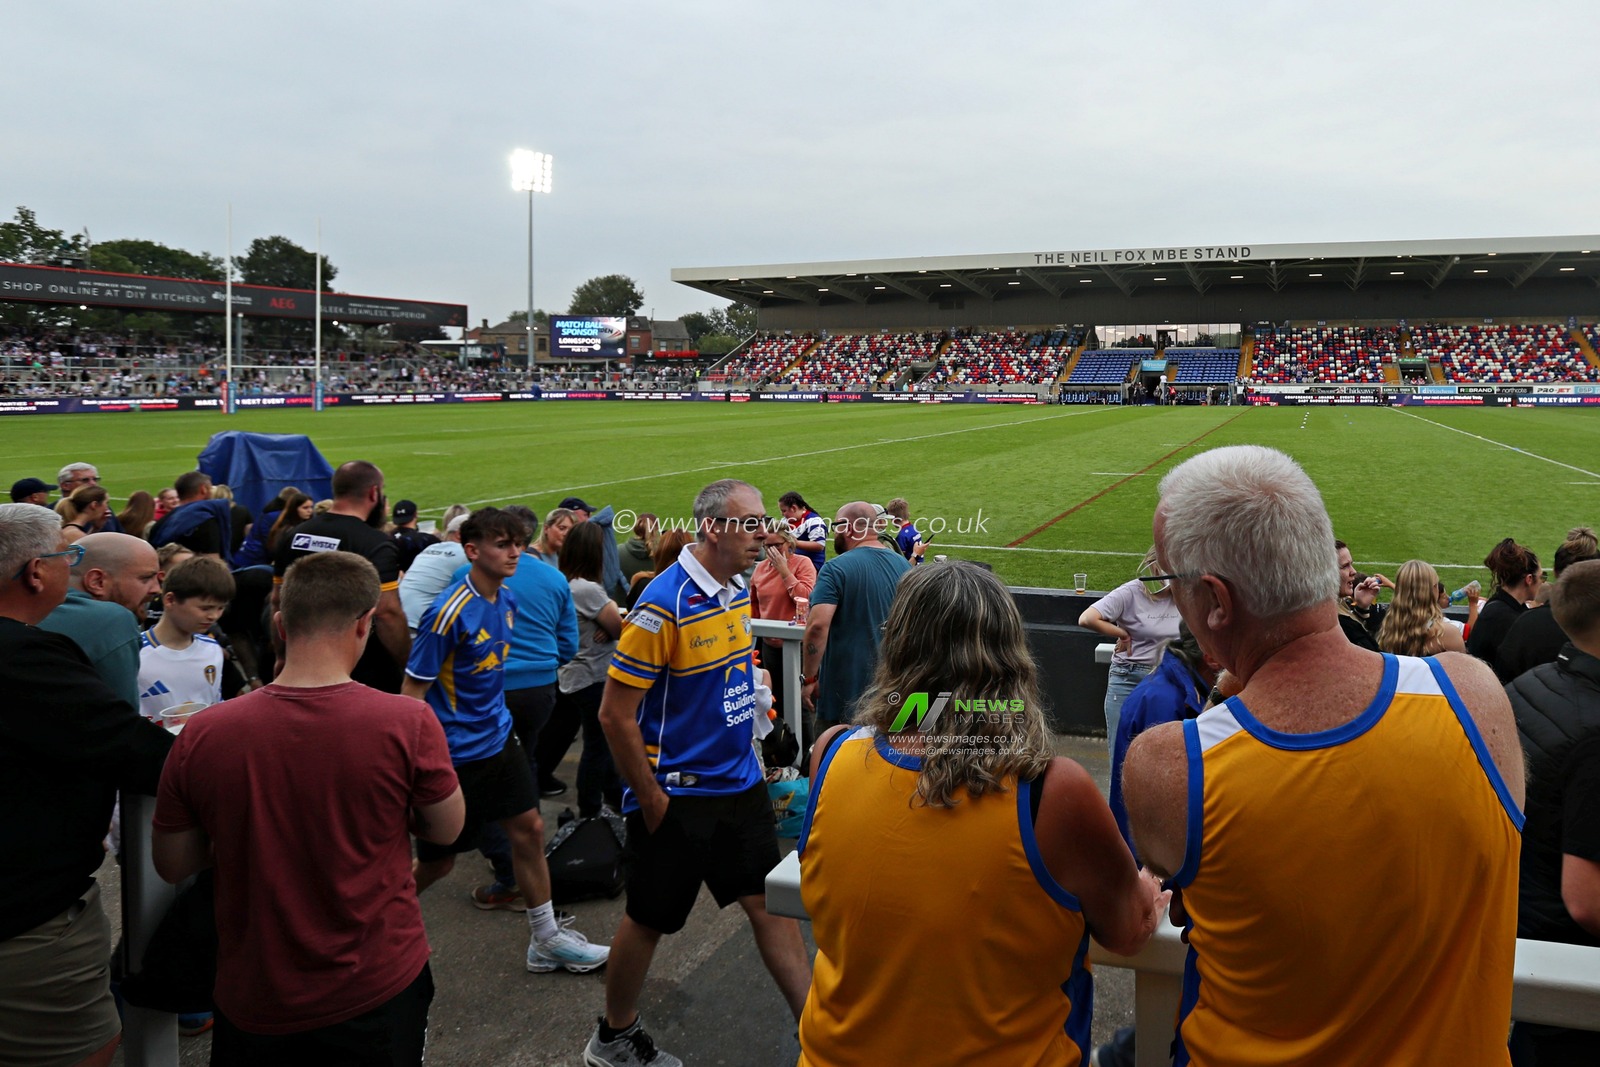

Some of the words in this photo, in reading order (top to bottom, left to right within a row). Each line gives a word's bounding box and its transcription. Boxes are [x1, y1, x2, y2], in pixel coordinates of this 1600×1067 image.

[1035, 253, 1065, 264] THE
[1071, 251, 1108, 263] NEIL
[1114, 250, 1146, 262] FOX
[1152, 248, 1188, 261] MBE
[1194, 246, 1251, 260] STAND
[3, 281, 43, 292] SHOP
[48, 284, 99, 297] ONLINE
[104, 289, 119, 298] AT
[125, 290, 146, 300] DIY
[151, 292, 207, 304] KITCHENS
[269, 297, 296, 309] AEG
[391, 310, 426, 319] SUPERIOR
[556, 320, 584, 329] MATCH
[585, 320, 603, 329] BALL
[561, 328, 599, 336] SPONSOR
[558, 337, 602, 345] LONGSPOON
